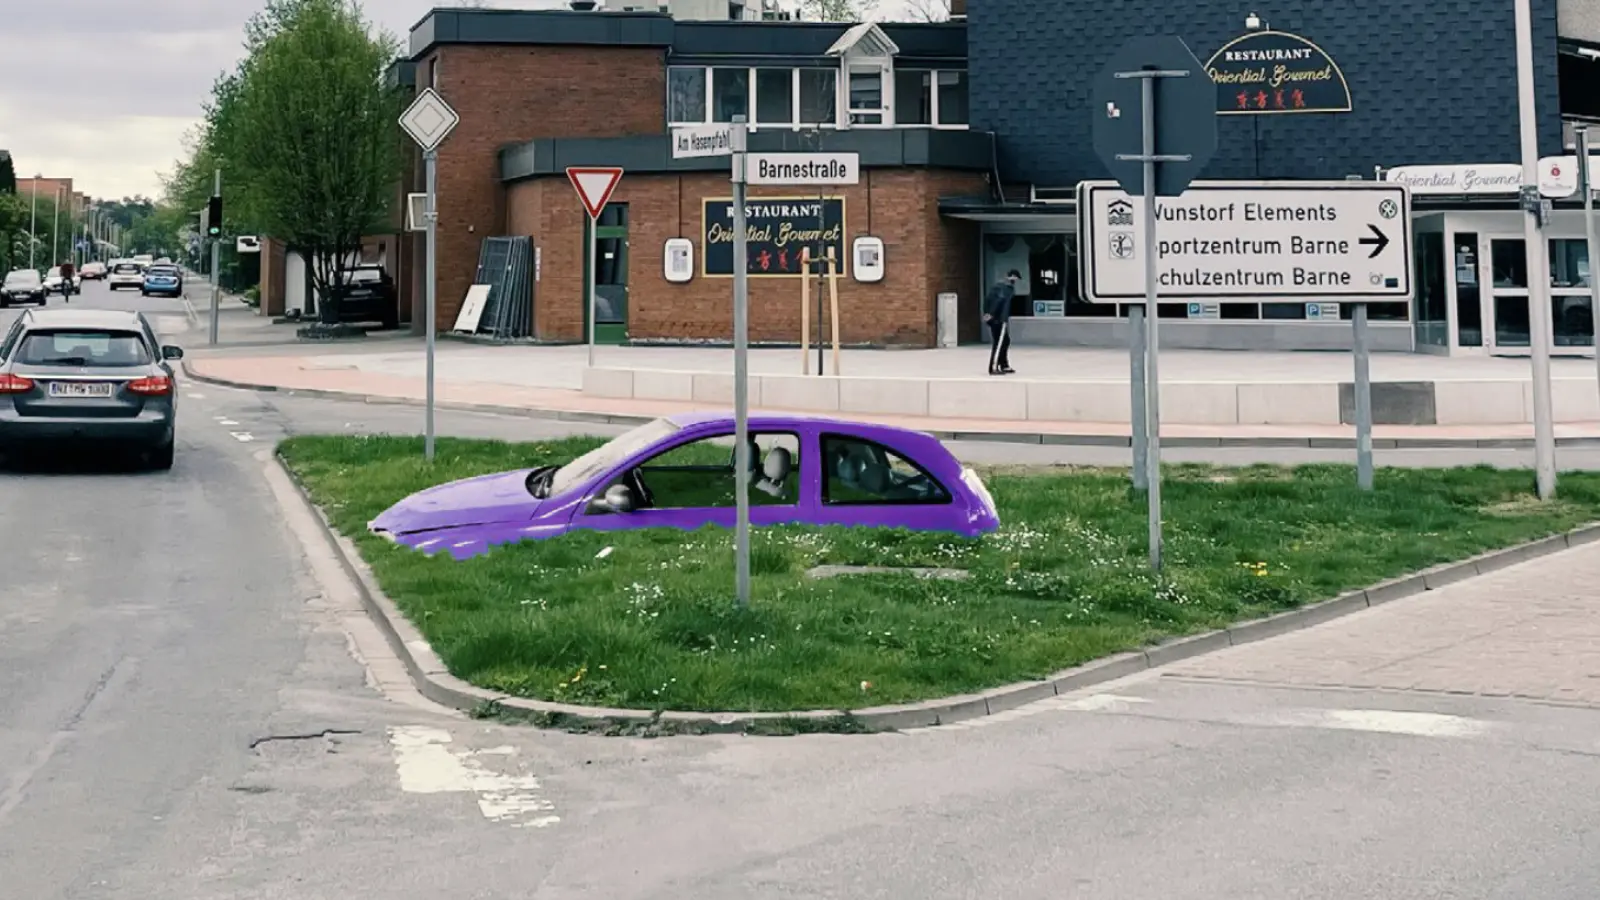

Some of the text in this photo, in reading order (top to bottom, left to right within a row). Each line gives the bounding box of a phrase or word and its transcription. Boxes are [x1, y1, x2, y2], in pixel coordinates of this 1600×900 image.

[1225, 49, 1312, 61] RESTAURANT
[1269, 65, 1332, 87] Gourmet
[677, 130, 730, 153] Am Hasenpfahl
[758, 159, 847, 178] Barnestraße
[726, 204, 821, 218] RSTAURANT
[1244, 203, 1337, 221] Elements
[707, 222, 771, 244] Oritial
[1156, 236, 1349, 259] portzentrum Barne
[1156, 267, 1352, 286] chulzentrum Barne
